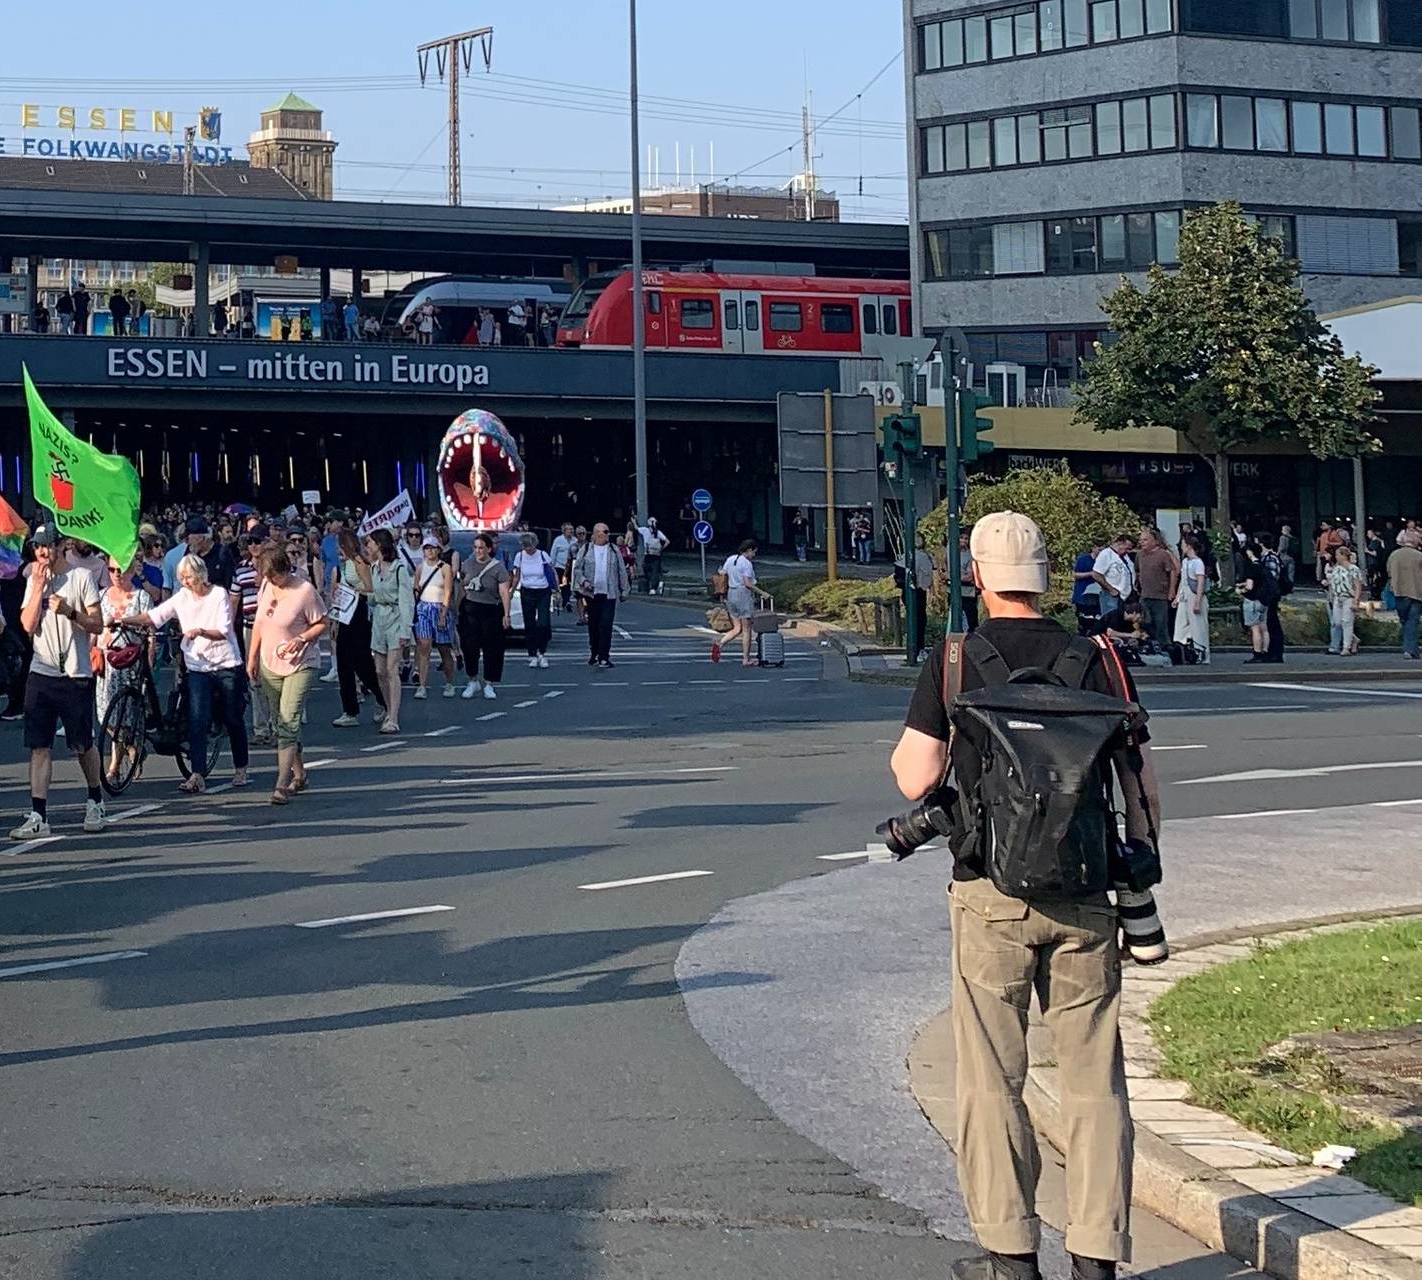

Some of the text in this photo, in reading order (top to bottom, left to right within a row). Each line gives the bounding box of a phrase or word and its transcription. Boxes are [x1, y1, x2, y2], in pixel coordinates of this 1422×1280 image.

[22, 104, 173, 133] ESSEN
[23, 138, 233, 164] FOLKWANGSTADT
[108, 348, 208, 378] ESSEN
[247, 352, 344, 382] mitten
[354, 354, 380, 382] in
[391, 355, 490, 392] Europa
[39, 421, 79, 465] NAZIS?
[1008, 454, 1062, 471] backWER
